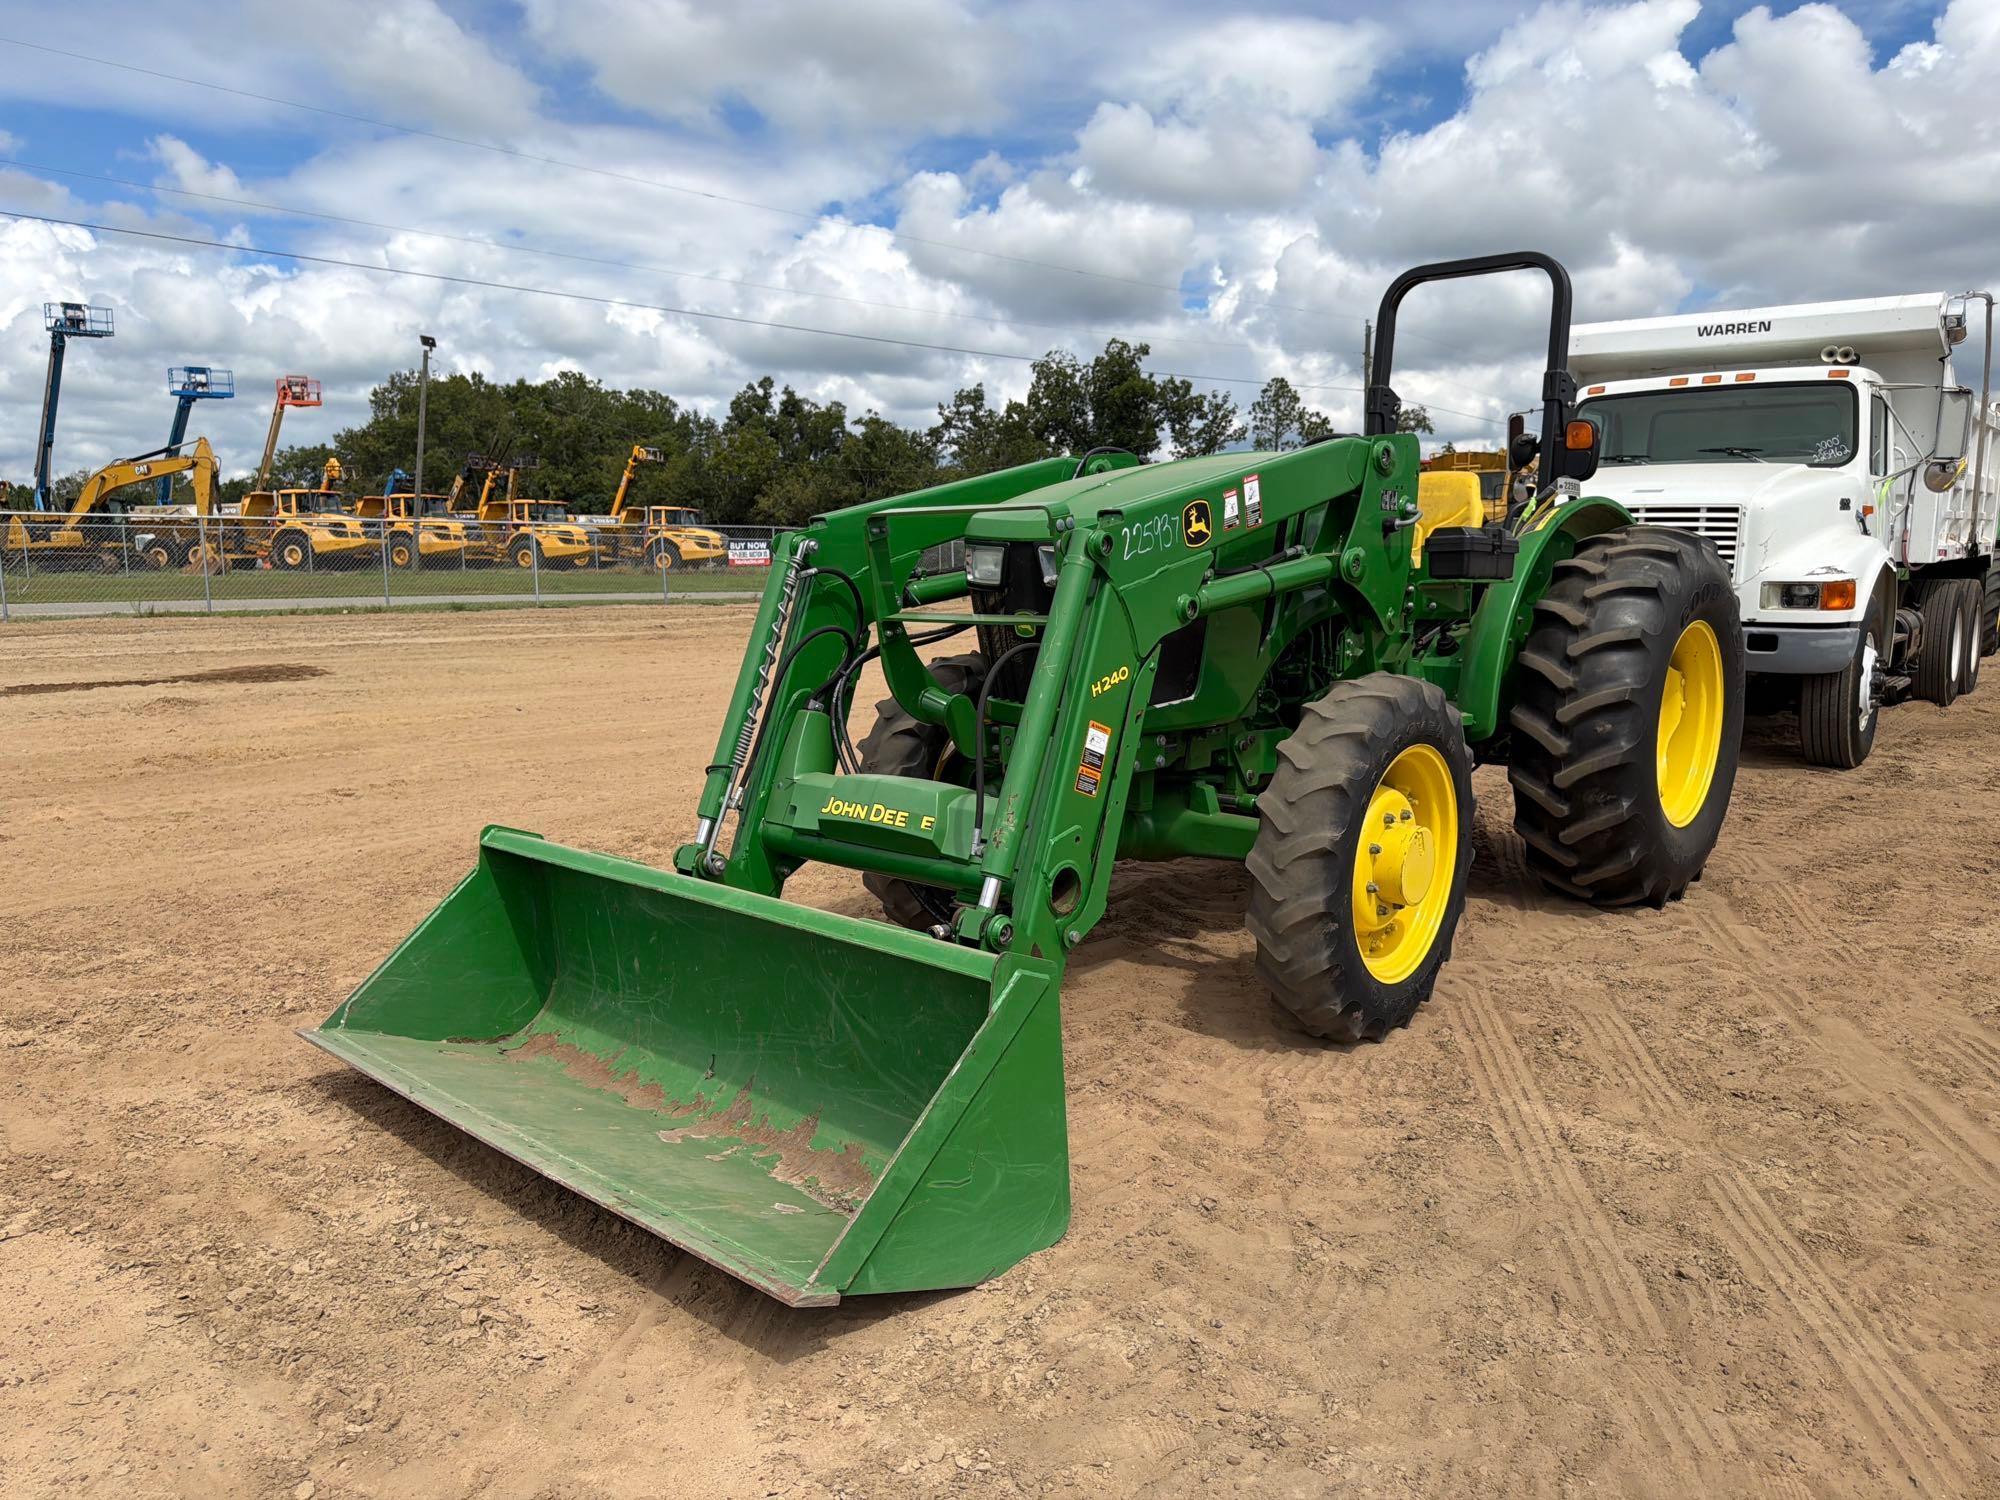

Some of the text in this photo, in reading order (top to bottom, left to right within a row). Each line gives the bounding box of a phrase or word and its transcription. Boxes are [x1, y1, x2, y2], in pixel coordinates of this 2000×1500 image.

[1697, 321, 1772, 337] WARREN
[135, 463, 148, 475] CAT
[730, 542, 767, 550] BUY NOW
[1122, 514, 1180, 561] 225937
[1092, 666, 1129, 698] H240
[821, 796, 869, 820] JOHN
